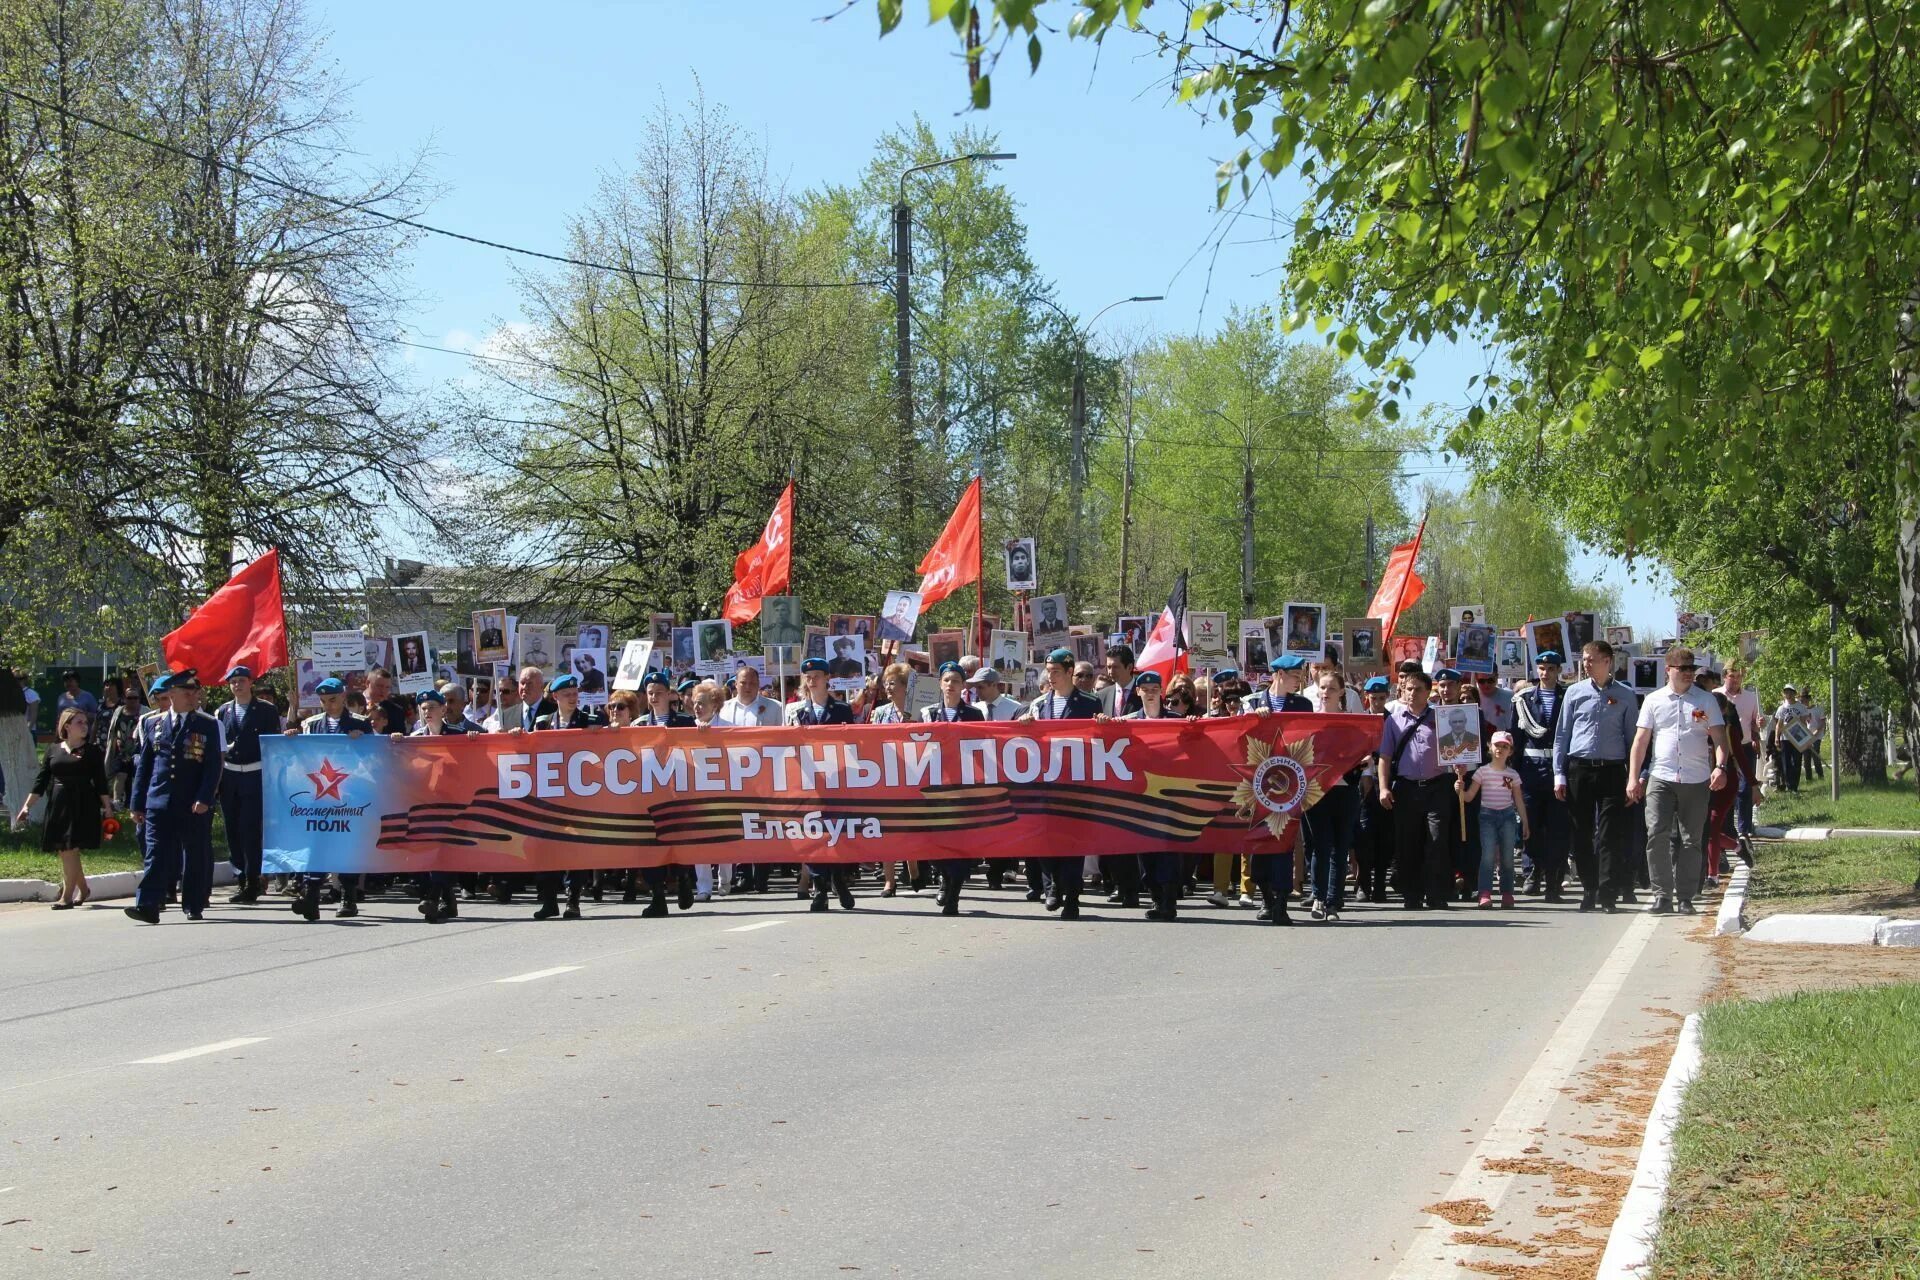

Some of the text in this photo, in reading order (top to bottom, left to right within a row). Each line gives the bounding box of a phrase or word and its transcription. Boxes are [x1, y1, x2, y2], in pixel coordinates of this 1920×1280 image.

[497, 732, 1133, 800] БЕССМЕРТНЫЙ ПОЛК
[1255, 758, 1306, 807] ОТЕЧЕСТВЕННАЯ ВОЙНА
[306, 819, 351, 832] ПОЛК
[741, 810, 883, 847] Елабуга
